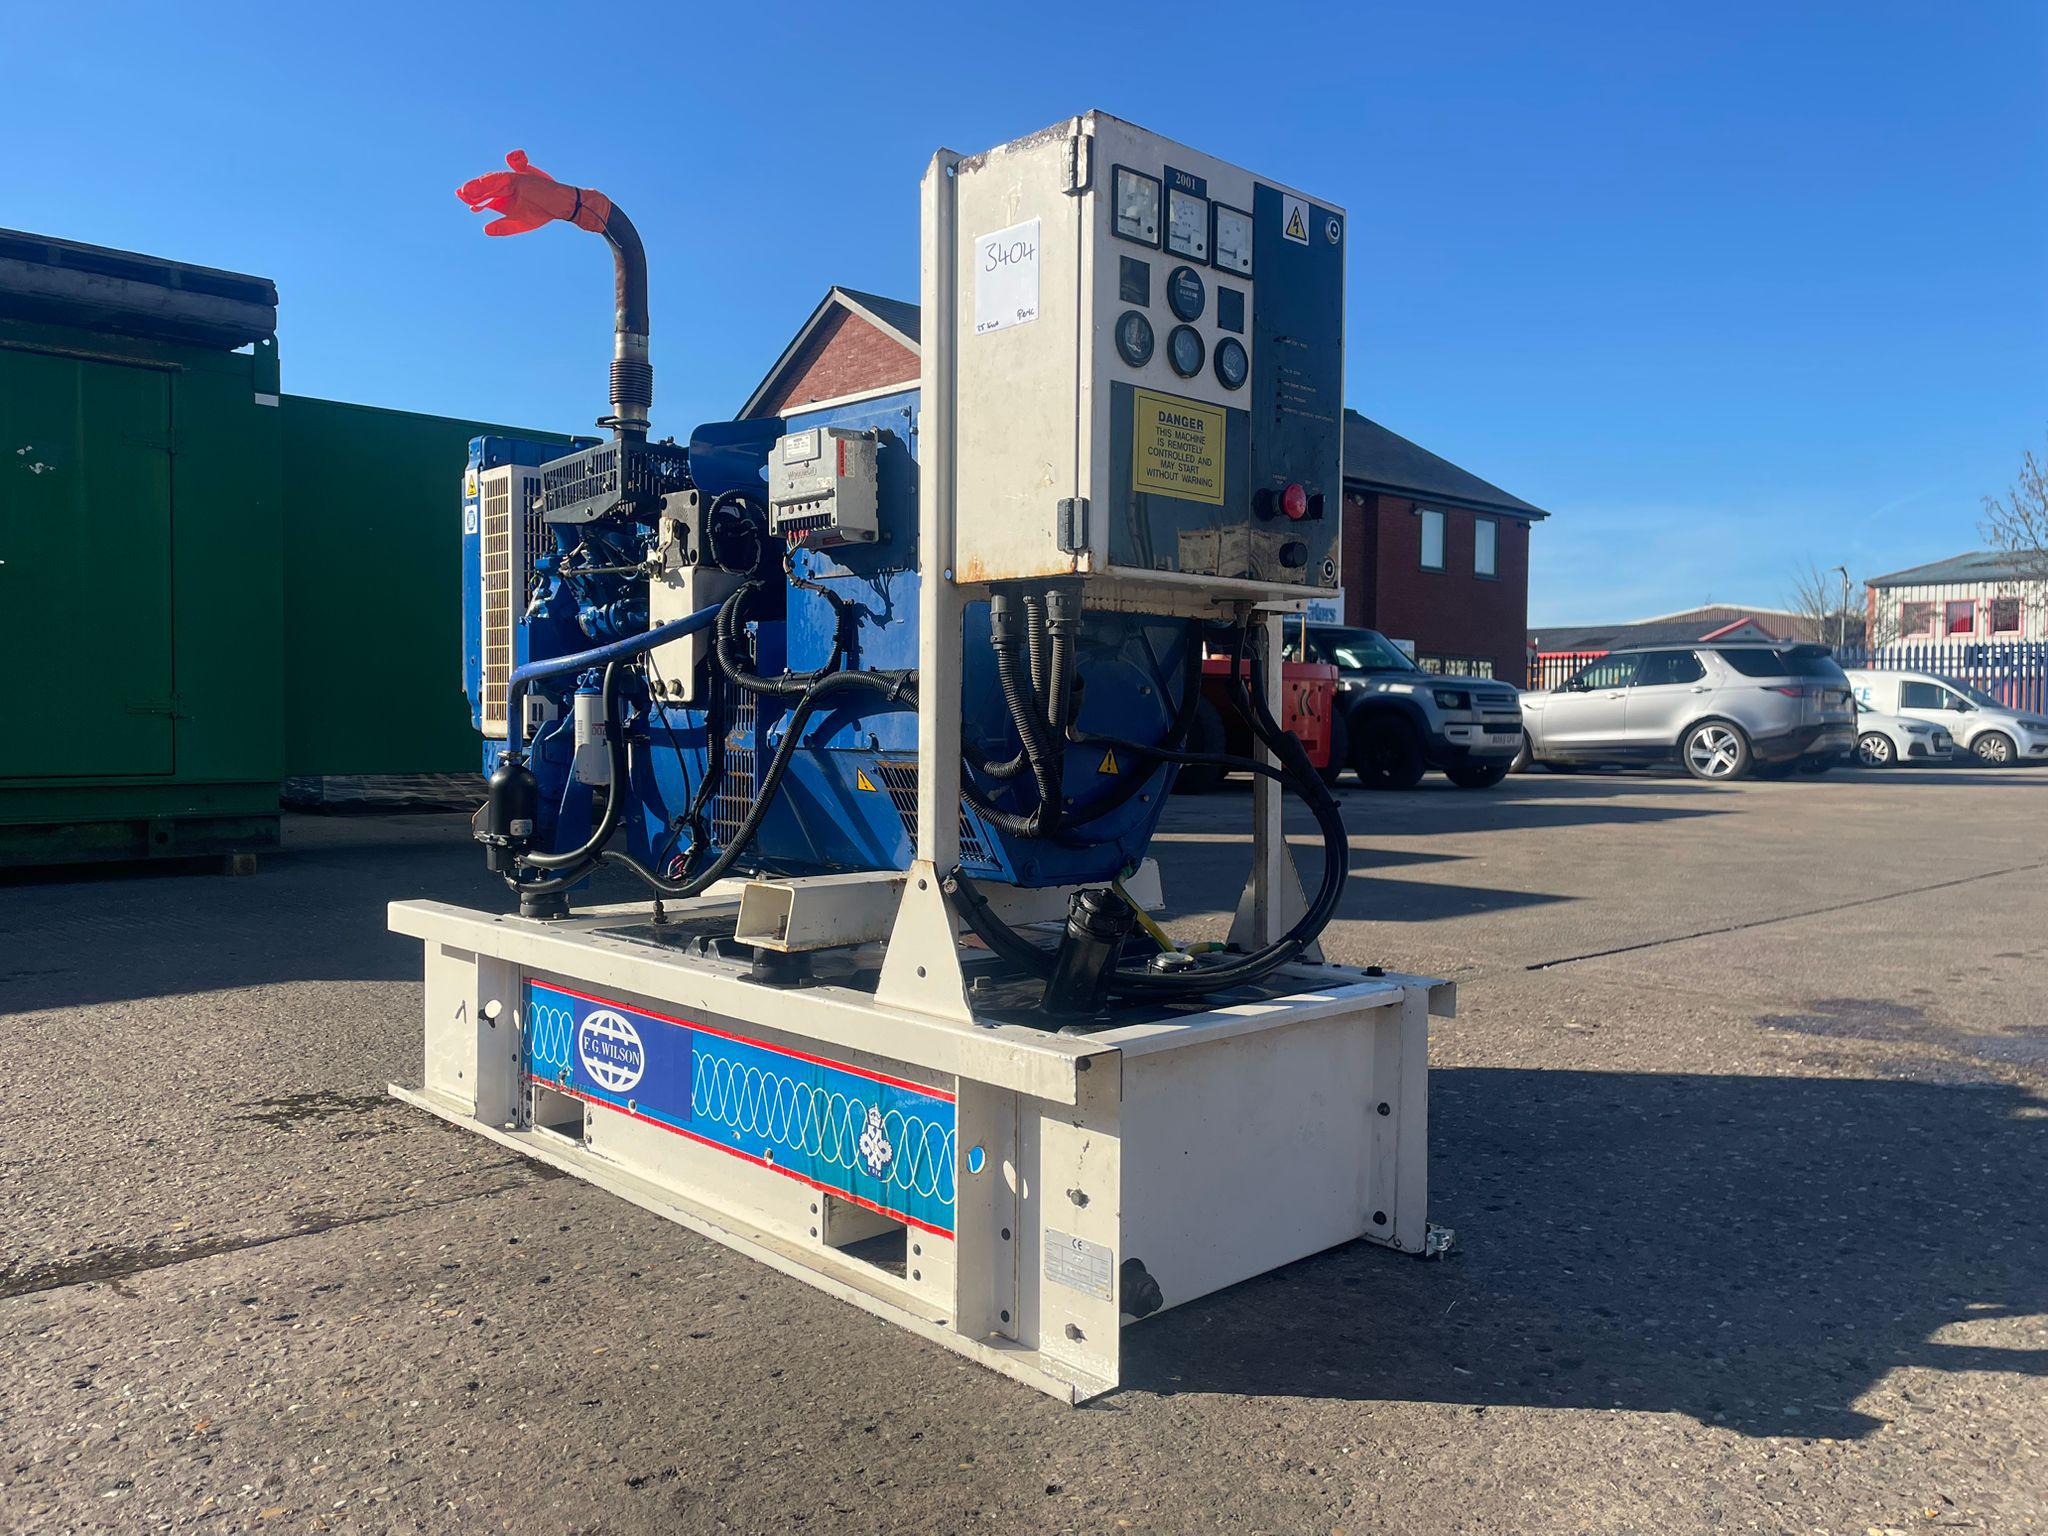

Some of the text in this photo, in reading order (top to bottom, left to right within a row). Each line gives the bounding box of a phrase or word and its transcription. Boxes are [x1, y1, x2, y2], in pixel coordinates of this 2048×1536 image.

[1175, 172, 1196, 190] 2001
[985, 241, 1036, 272] 3404
[1158, 411, 1204, 431] DANGER
[1156, 427, 1206, 446] THIS MACHINE
[1157, 438, 1204, 454] IS REMOTELY
[1147, 446, 1213, 467] CONTROLLED AND
[1160, 460, 1200, 474] MAY START
[1146, 467, 1213, 488] WITHOUT WARNING
